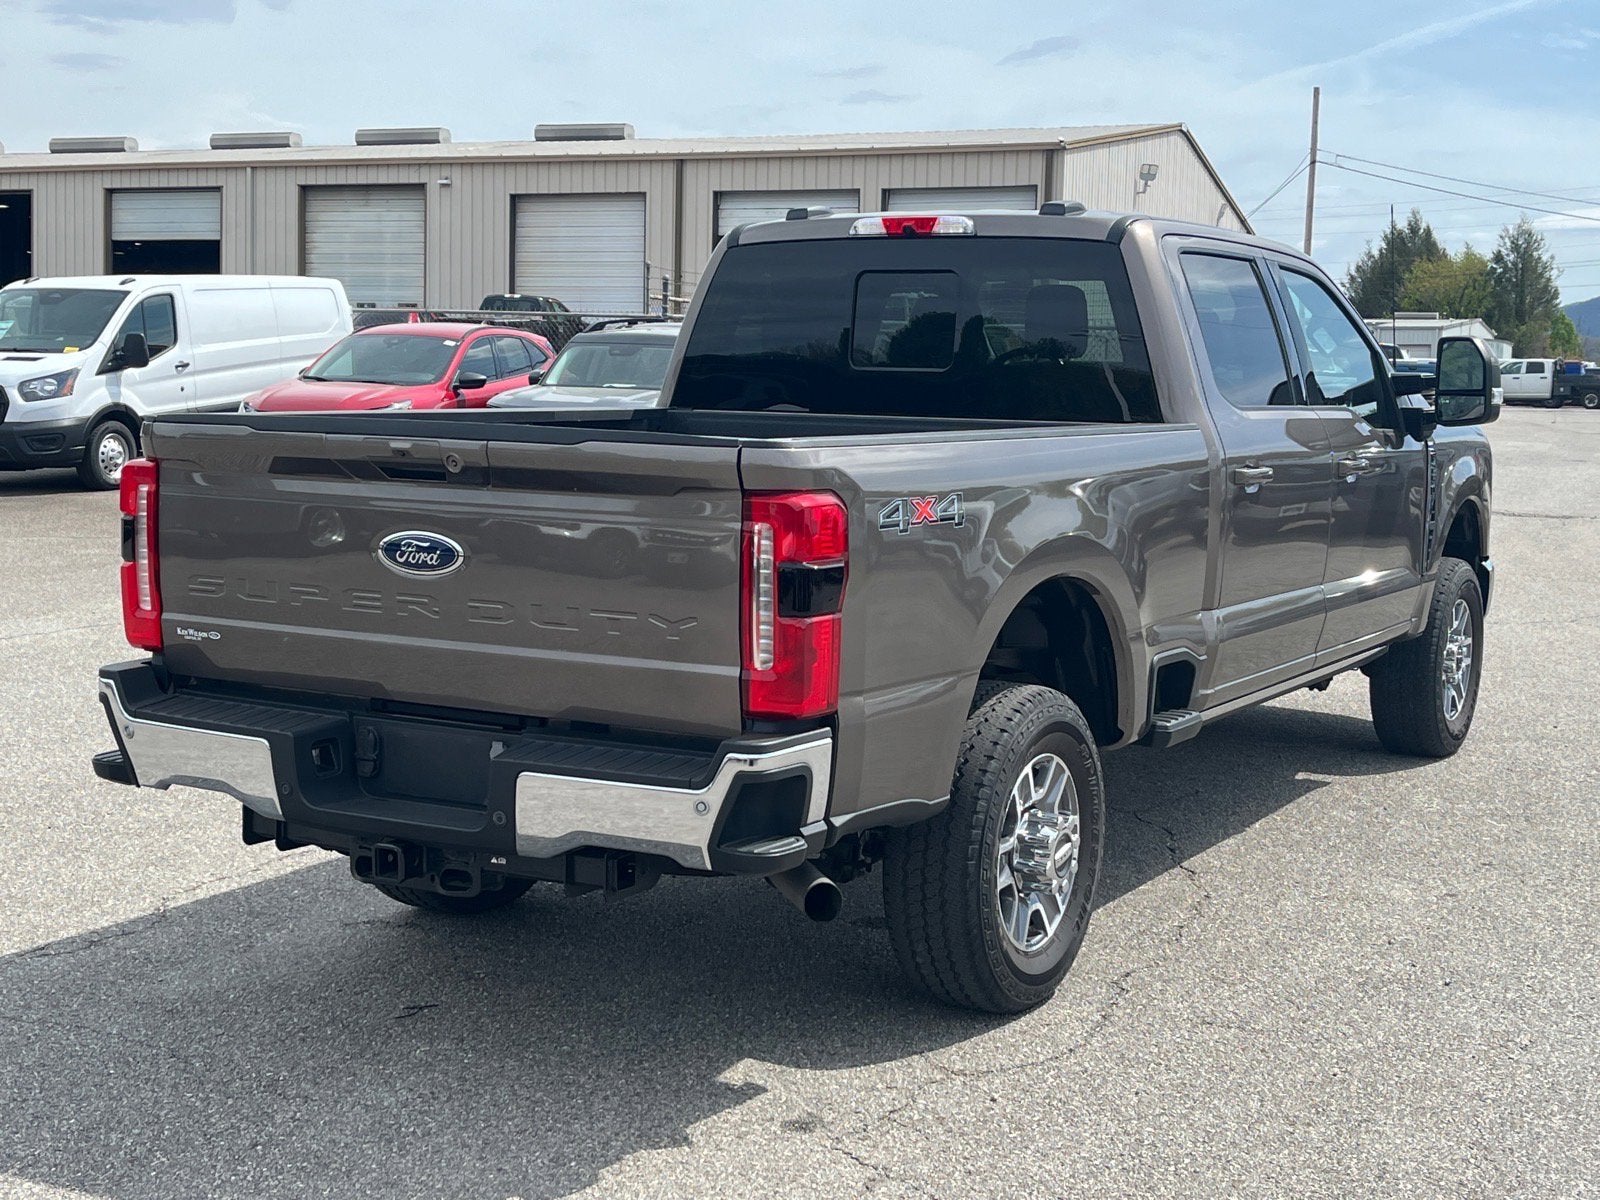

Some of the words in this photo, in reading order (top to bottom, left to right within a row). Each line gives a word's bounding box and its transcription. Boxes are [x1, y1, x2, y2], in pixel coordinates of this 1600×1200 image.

[395, 539, 441, 566] Ford
[188, 574, 440, 619] SUPER
[467, 598, 698, 641] DUTY
